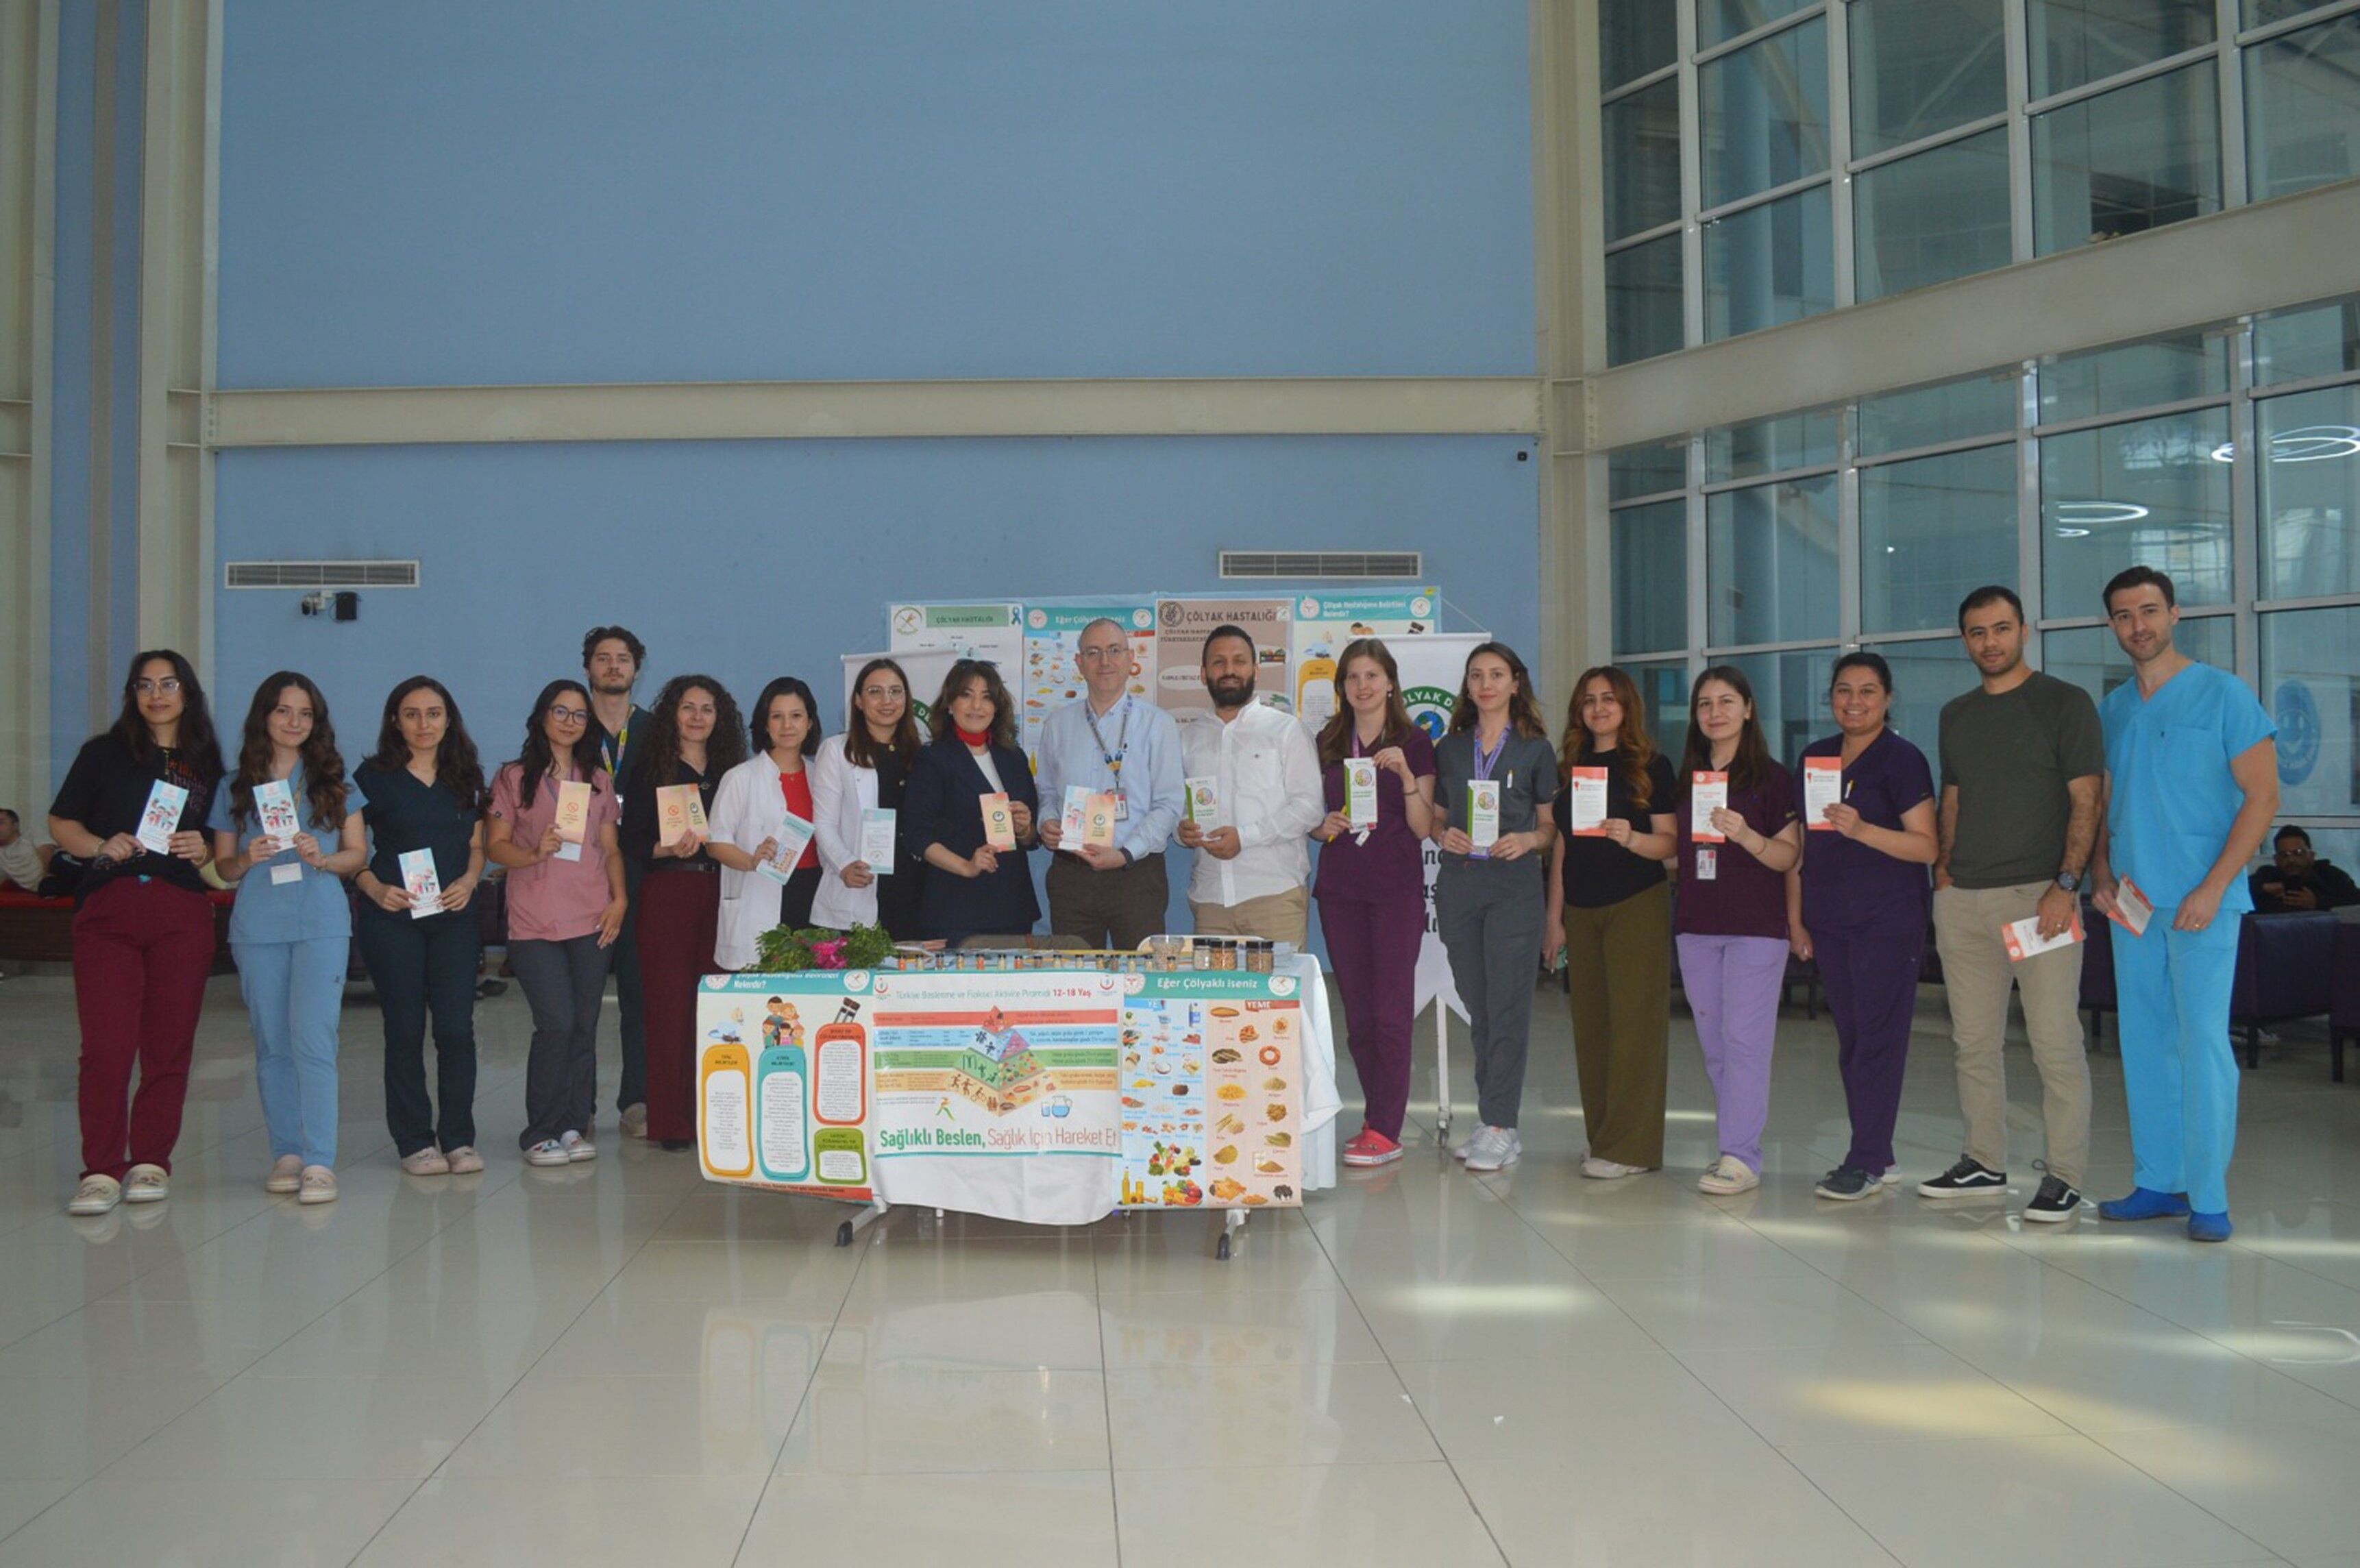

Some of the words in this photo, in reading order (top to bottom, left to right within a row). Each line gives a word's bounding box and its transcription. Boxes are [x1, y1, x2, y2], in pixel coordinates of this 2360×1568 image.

[1186, 610, 1224, 624] ÇÖLYAK
[1157, 977, 1181, 989] Eğer
[1183, 977, 1225, 990] Çölyaklı
[1053, 988, 1076, 997] 12-18
[1077, 988, 1092, 998] Yaş
[880, 1127, 932, 1151] Sağlıklı
[936, 1128, 986, 1149] Beslen,
[987, 1128, 1027, 1150] Sağlık
[1055, 1127, 1103, 1147] Hareket
